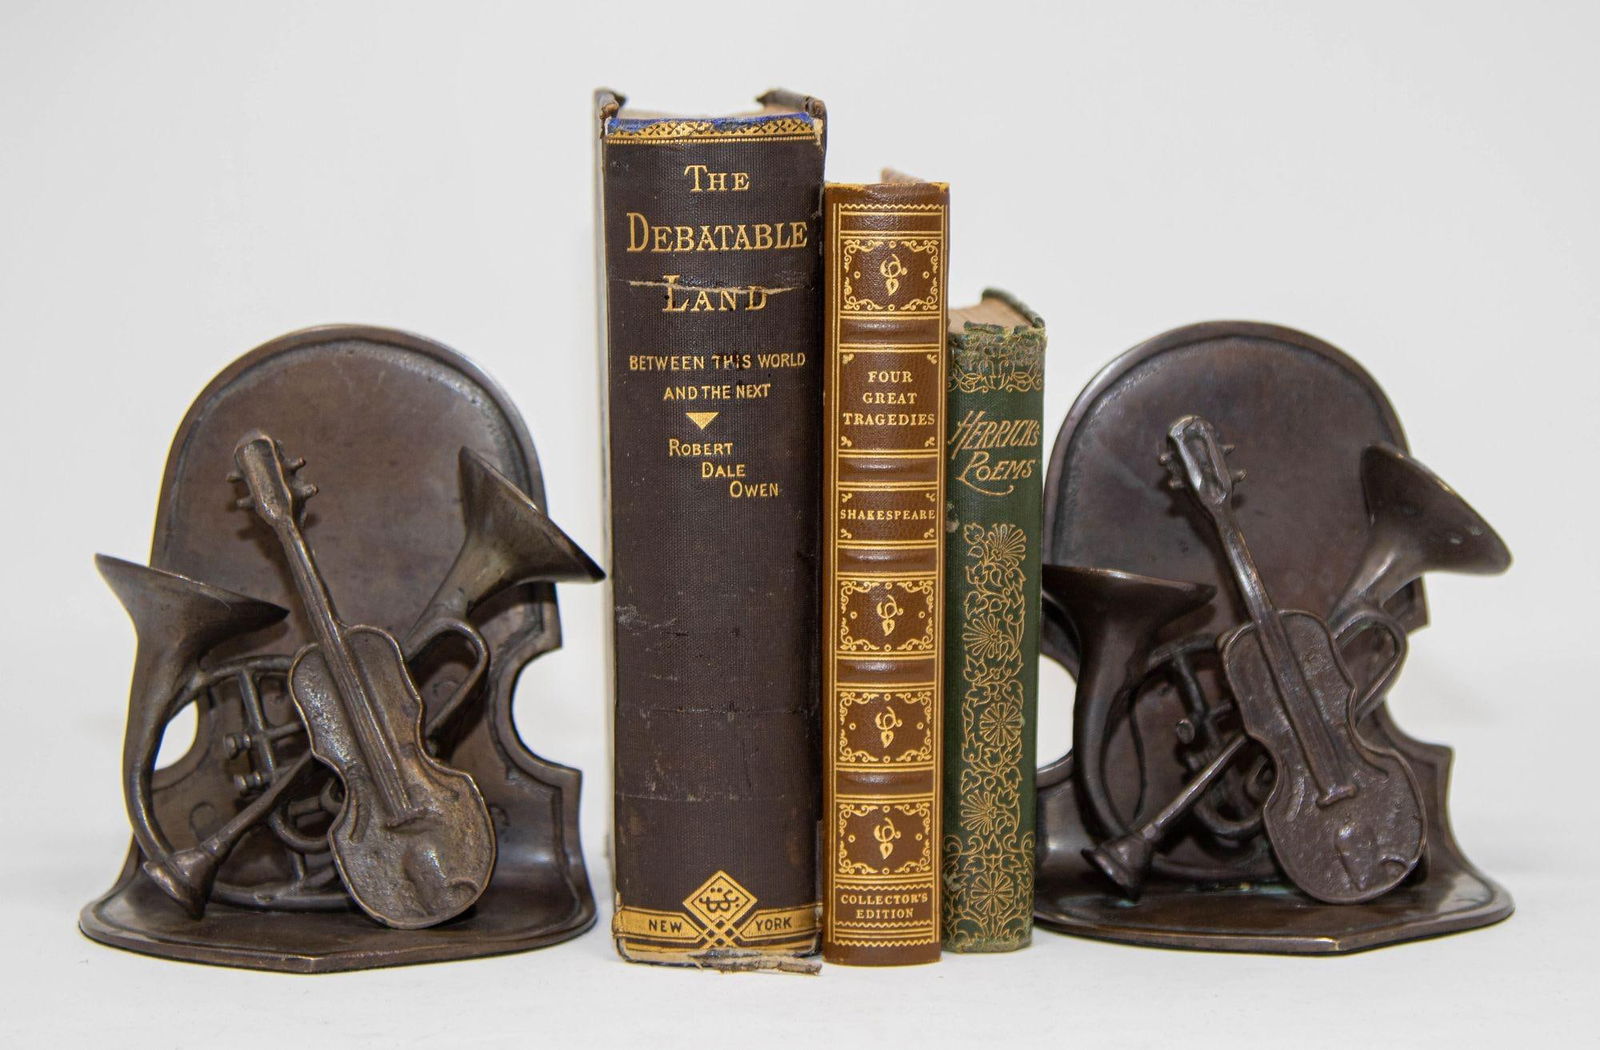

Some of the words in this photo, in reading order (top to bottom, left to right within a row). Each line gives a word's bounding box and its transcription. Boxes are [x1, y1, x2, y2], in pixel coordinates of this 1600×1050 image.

[684, 164, 750, 192] THE
[626, 212, 808, 253] DEBATABLE
[662, 274, 768, 312] LAND
[629, 356, 704, 371] BETWEEN
[711, 355, 751, 370] THIS
[758, 353, 806, 368] WORLD
[867, 371, 913, 383] FOUR
[663, 387, 698, 401] AND
[701, 386, 731, 399] THE
[736, 384, 771, 399] NEXT
[862, 393, 918, 404] GREAT
[843, 413, 935, 426] TRAGEDIES
[669, 439, 733, 456] ROBERT
[702, 462, 746, 478] DALE
[955, 451, 1036, 496] POEMS
[730, 481, 779, 498] OWEN
[840, 510, 936, 521] SHAKESPEARE
[840, 893, 928, 905] COLLECTOR'S
[856, 908, 913, 919] EDITION
[648, 920, 682, 933] NEW
[754, 917, 793, 931] YORK
